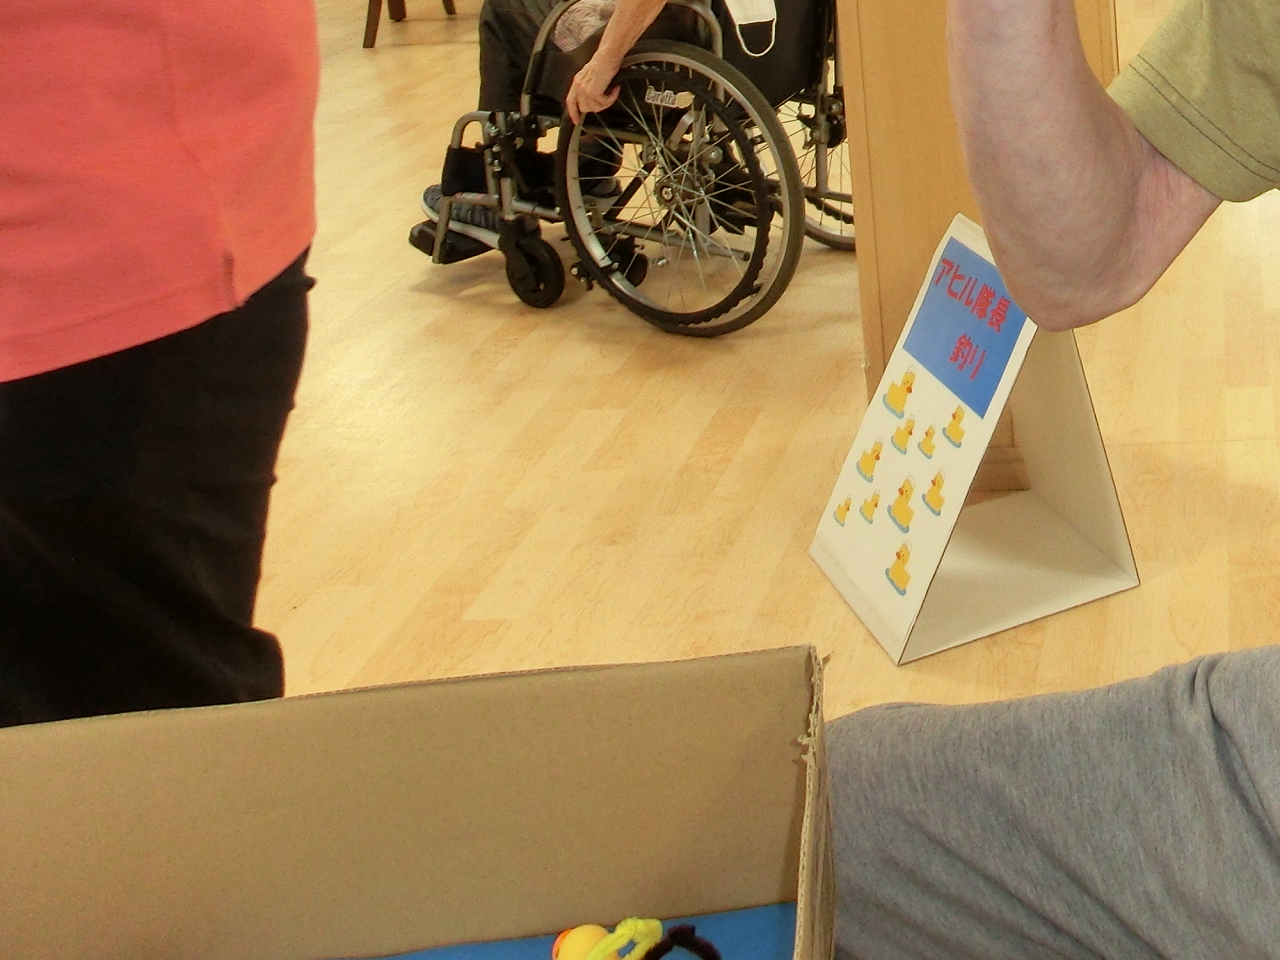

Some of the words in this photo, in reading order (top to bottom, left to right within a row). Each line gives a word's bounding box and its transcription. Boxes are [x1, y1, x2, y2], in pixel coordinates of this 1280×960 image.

[935, 258, 1011, 332] アヒル隊長
[949, 333, 985, 380] 釣り
